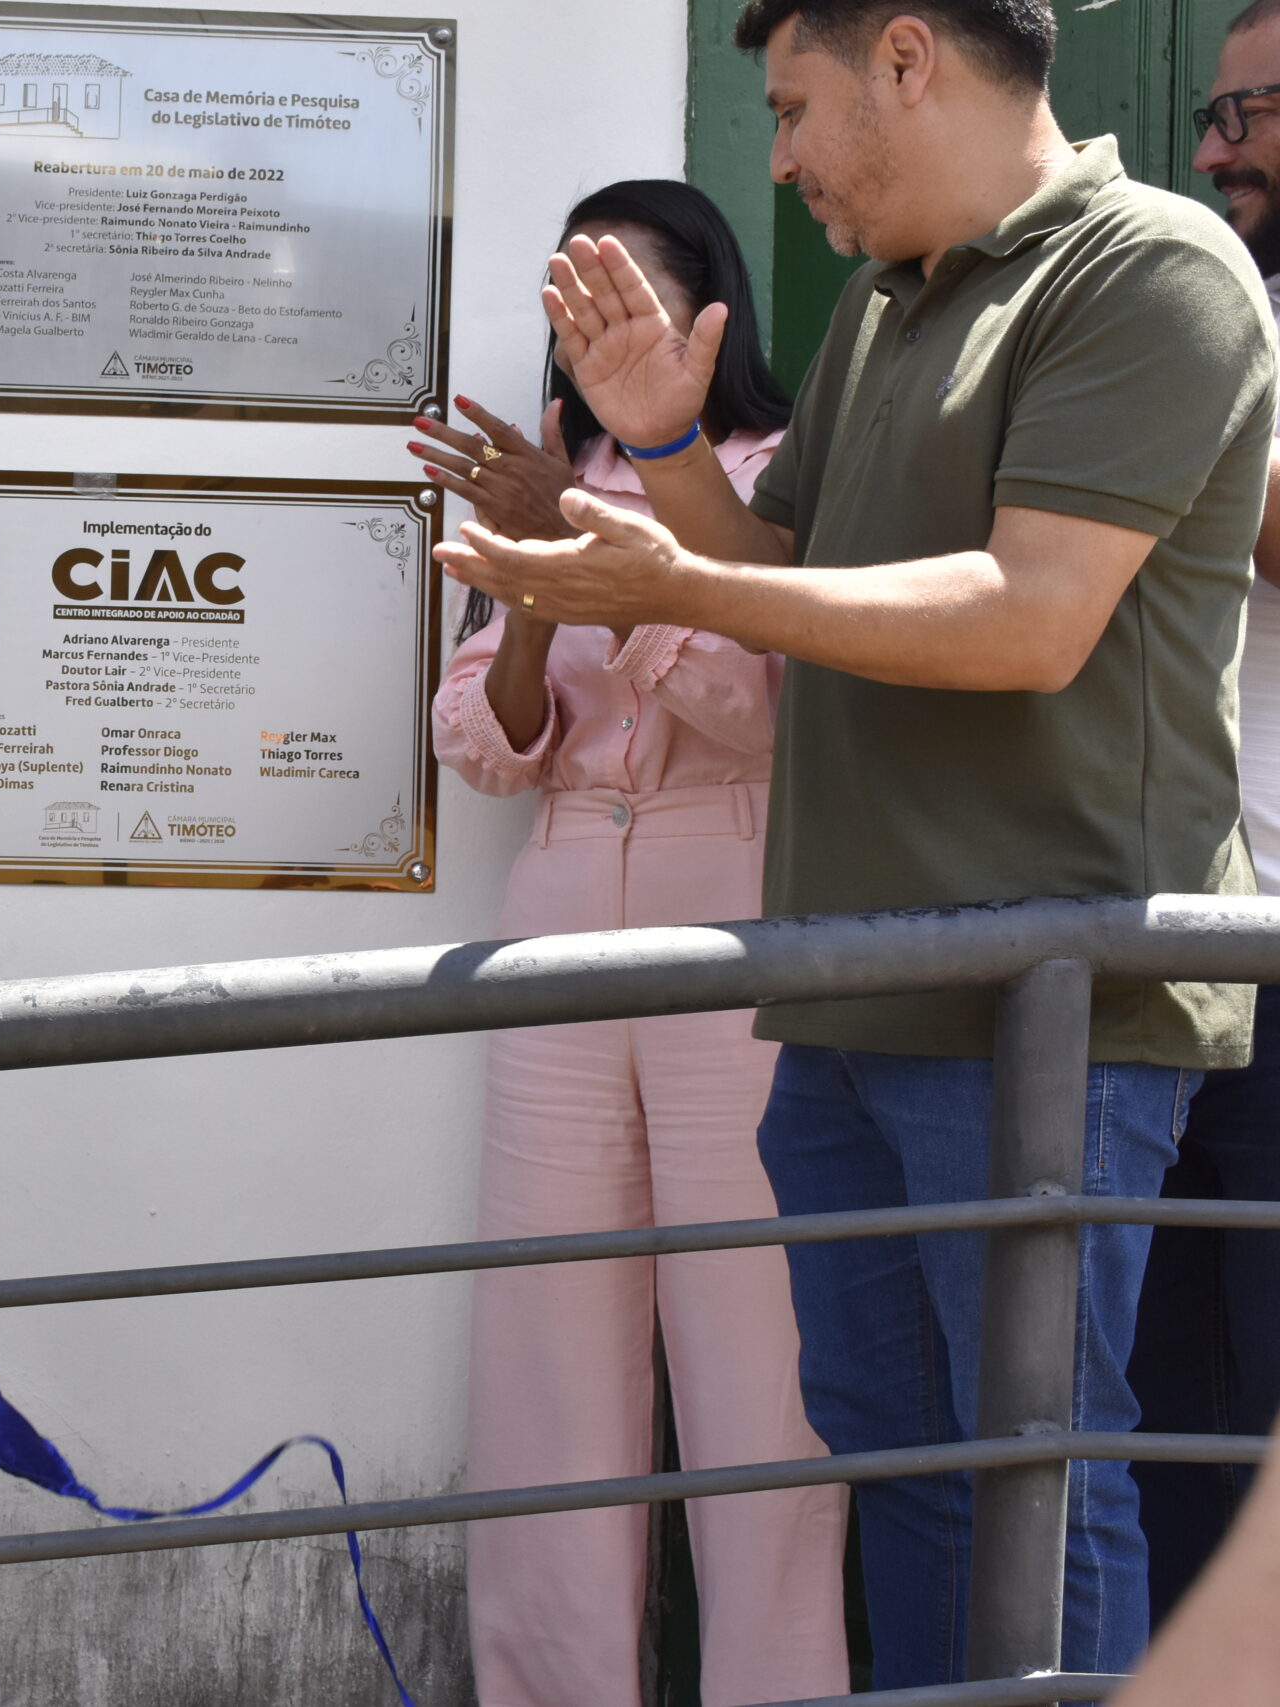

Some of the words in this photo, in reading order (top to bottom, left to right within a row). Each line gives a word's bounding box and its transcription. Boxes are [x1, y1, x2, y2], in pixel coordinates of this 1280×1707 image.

[144, 88, 180, 103] Casa
[183, 90, 201, 104] de
[206, 90, 275, 106] Memória
[278, 96, 287, 106] e
[291, 93, 360, 112] Pesquisa
[152, 111, 171, 124] do
[174, 111, 260, 130] Legislativo
[263, 114, 282, 128] de
[286, 115, 351, 130] Timóteo
[33, 160, 117, 176] Reabertura
[120, 166, 142, 177] em
[146, 164, 163, 177] 20
[168, 164, 184, 178] de
[188, 165, 224, 179] maio
[227, 166, 245, 180] de
[249, 167, 283, 181] 2022
[68, 187, 122, 198] Presidente:
[126, 188, 147, 199] Luiz
[150, 189, 197, 203] Gonzaga
[199, 190, 247, 204] Perdigão
[117, 202, 140, 213] José
[143, 203, 194, 214] Fernando
[196, 205, 238, 216] Moreira
[240, 206, 280, 217] Peixoto
[100, 216, 155, 228] Raimundo
[158, 218, 197, 229] Nonato
[199, 219, 230, 230] Vieira
[238, 220, 310, 233] Raimundinho
[82, 228, 132, 240] secretário:
[136, 230, 172, 244] Thiago
[175, 232, 207, 243] Torres
[209, 233, 247, 244] Coelho
[56, 242, 105, 254] secretária:
[109, 243, 139, 255] Sônia
[141, 245, 179, 256] Ribeiro
[181, 246, 195, 257] da
[197, 247, 223, 258] Silva
[225, 248, 270, 259] Andrade
[26, 268, 77, 282] Alvarenga
[131, 272, 151, 282] José
[154, 273, 207, 285] Almerindo
[209, 275, 244, 286] Ribeiro
[252, 276, 292, 288] Nelinho
[26, 282, 64, 294] Ferreira
[130, 286, 166, 299] Reygler
[169, 287, 189, 298] Max
[192, 288, 225, 299] Cunha
[42, 297, 60, 308] dos
[62, 298, 96, 309] Santos
[129, 300, 170, 311] Roberto
[184, 302, 196, 312] de
[199, 303, 230, 314] Souza
[238, 304, 261, 315] Beto
[263, 305, 277, 316] do
[279, 306, 342, 318] Estofamento
[71, 312, 90, 323] BIM
[129, 314, 170, 325] Ronaldo
[172, 315, 208, 327] Ribeiro
[209, 317, 254, 331] Gonzaga
[33, 325, 84, 337] Gualberto
[129, 328, 172, 339] Wladimir
[174, 329, 215, 341] Geraldo
[216, 331, 229, 342] de
[232, 332, 256, 343] Lana
[264, 333, 298, 344] Careca
[134, 362, 194, 376] TIMÓTEO
[83, 519, 192, 539] Implementação
[194, 523, 212, 536] do
[55, 607, 91, 617] CENTRO
[91, 609, 143, 619] INTEGRADO
[144, 610, 156, 619] DE
[157, 610, 185, 620] APOIO
[186, 612, 199, 620] AO
[200, 610, 240, 621] CIDADÃO
[63, 634, 109, 645] Adriano
[111, 635, 170, 649] Alvarenga
[181, 637, 238, 648] Presidente
[42, 649, 84, 660] Marcus
[86, 650, 148, 661] Fernandes
[61, 664, 102, 675] Doutor
[104, 665, 127, 676] Lair
[45, 680, 90, 691] Pastora
[92, 680, 124, 692] Sônia
[126, 682, 175, 693] Andrade
[200, 683, 255, 695] Secretário
[65, 696, 91, 706] Fred
[94, 696, 154, 708] Gualberto
[180, 699, 235, 710] Secretário
[101, 728, 134, 738] Omar
[138, 728, 181, 739] Onraca
[310, 732, 336, 743] Max
[101, 746, 159, 756] Professor
[163, 746, 199, 759] Diogo
[260, 749, 302, 762] Thiago
[305, 750, 343, 761] Torres
[18, 761, 83, 775] (Suplente)
[100, 763, 183, 775] Raimundinho
[186, 765, 232, 776] Nonato
[260, 767, 315, 778] Wladimir
[318, 768, 360, 779] Careca
[100, 781, 144, 792] Renara
[146, 782, 195, 793] Cristina
[167, 822, 236, 838] TIMÓTEO
